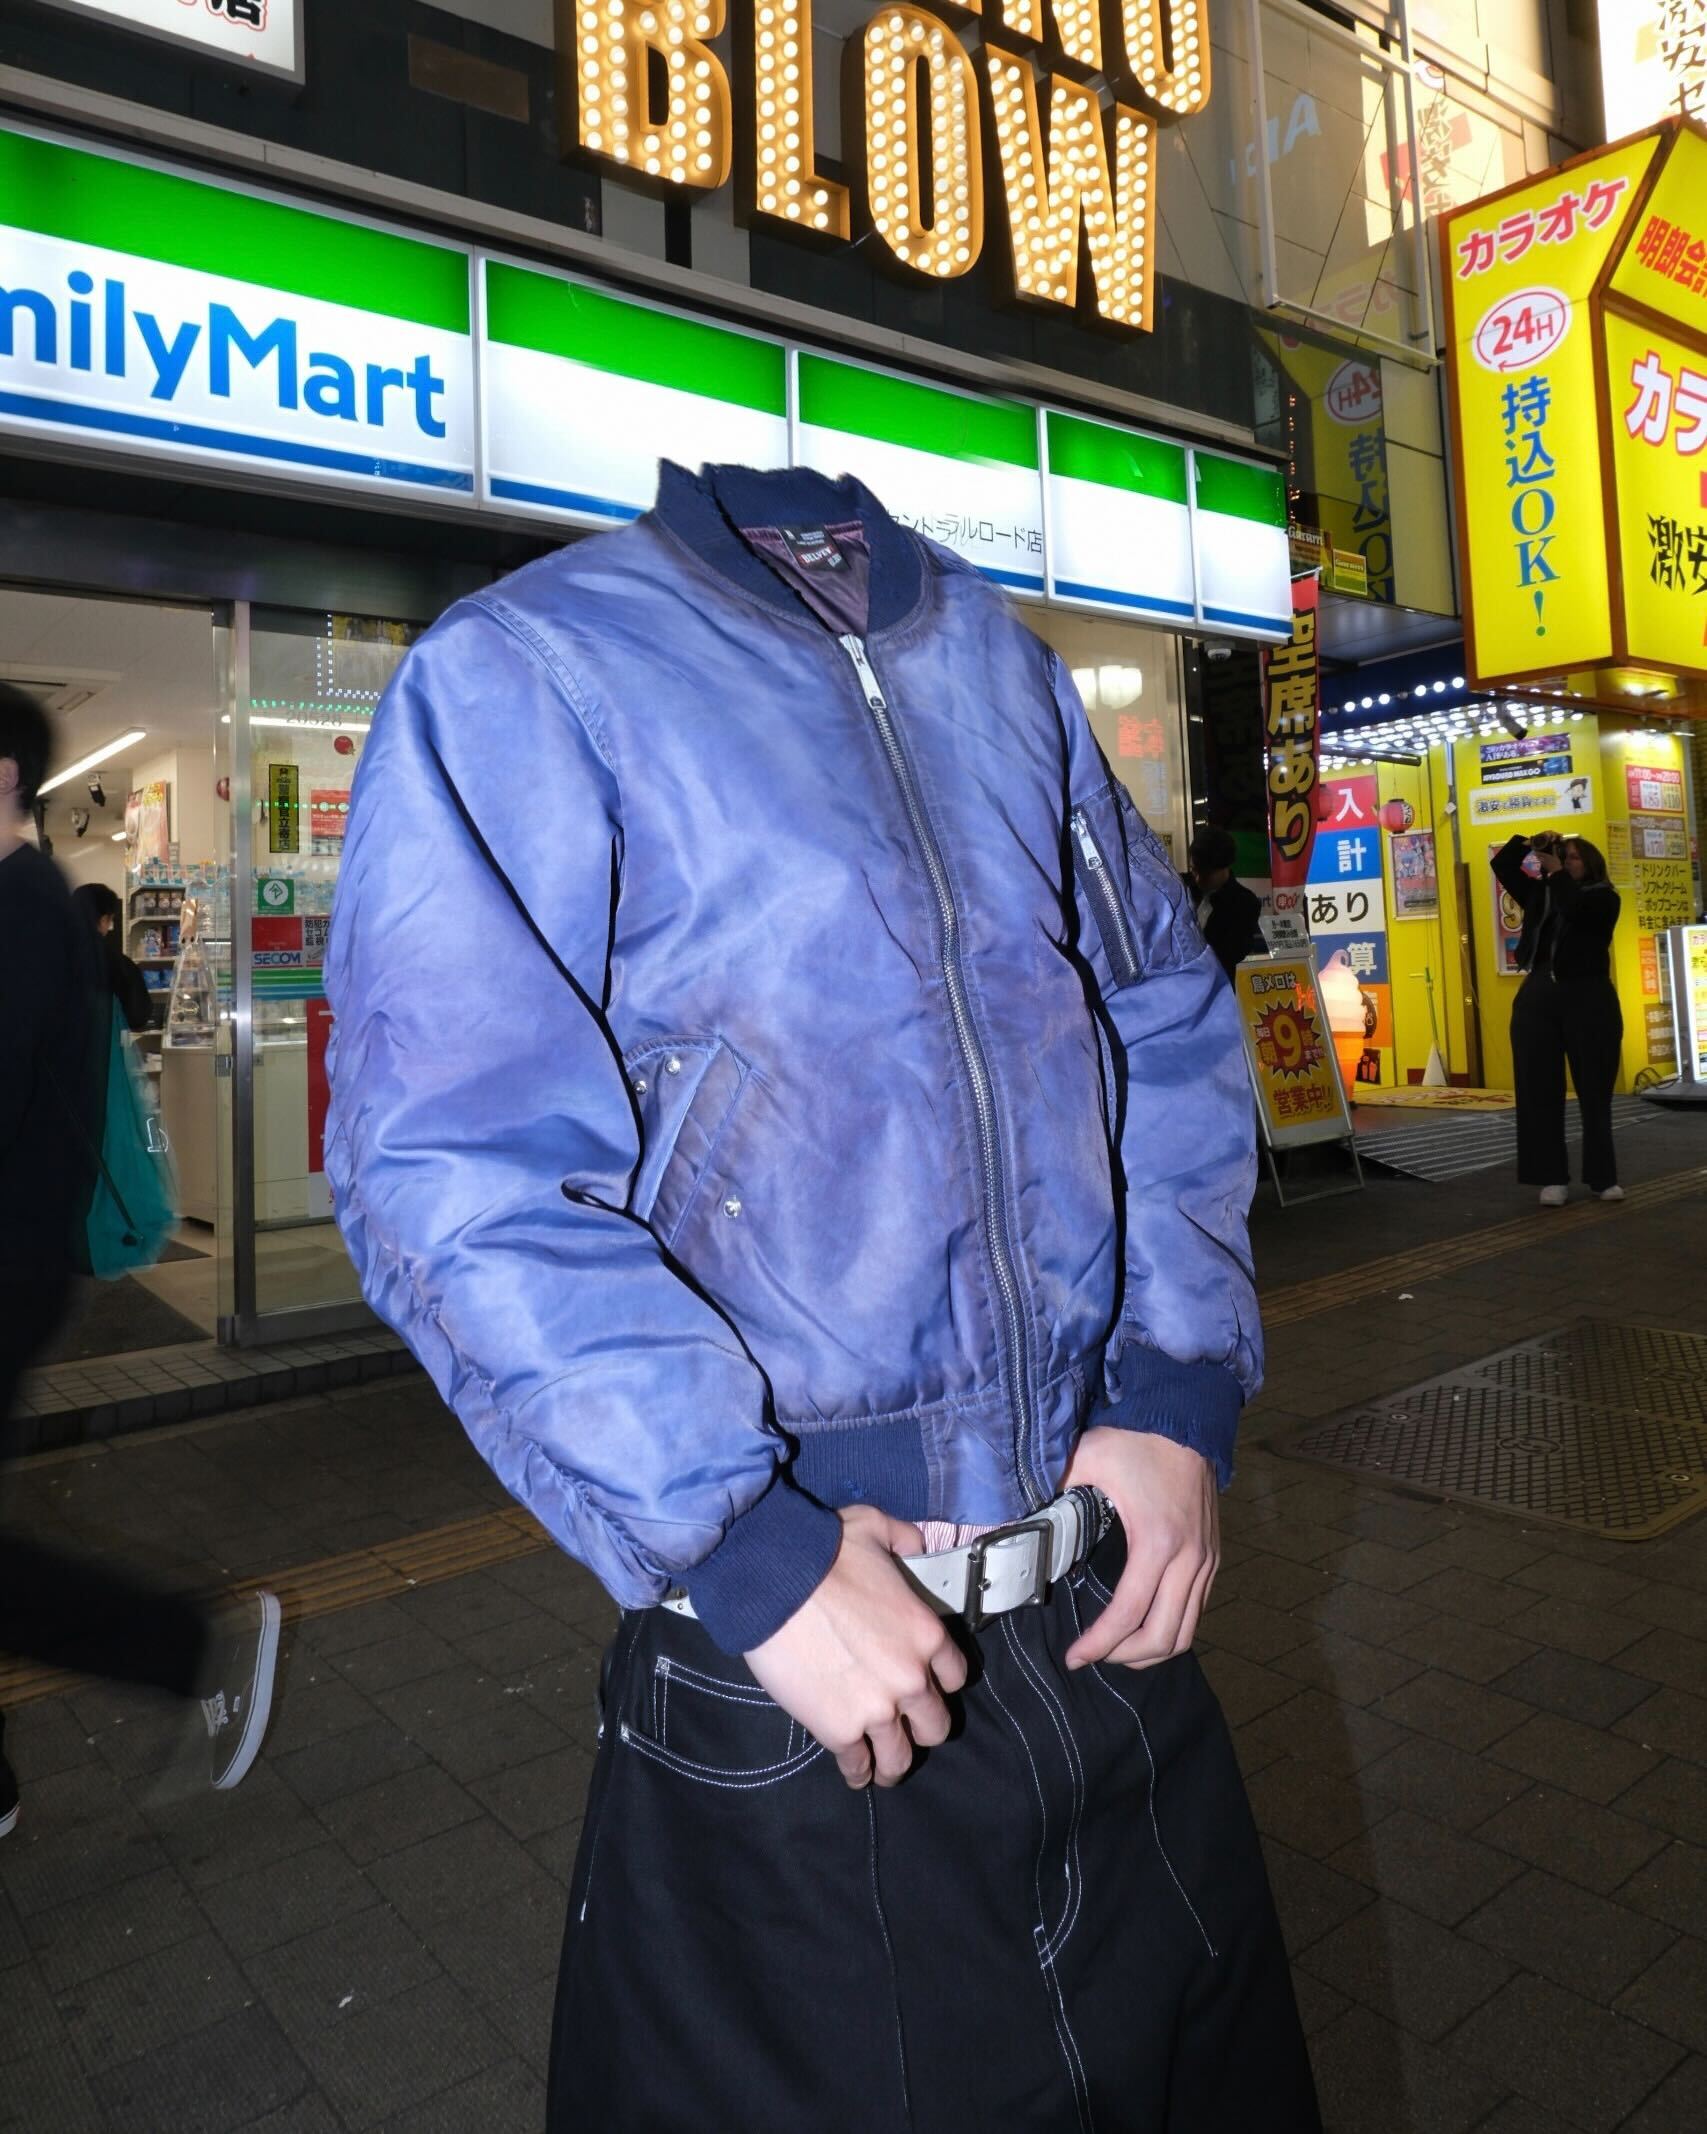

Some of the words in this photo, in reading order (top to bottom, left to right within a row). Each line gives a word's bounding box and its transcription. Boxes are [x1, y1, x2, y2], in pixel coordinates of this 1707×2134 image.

[574, 0, 1158, 333] BLOW
[1458, 178, 1628, 277] カラオケ
[1491, 306, 1555, 357] 24H
[1335, 787, 1364, 822] 入
[1337, 837, 1367, 873] 計
[254, 952, 301, 965] SECOM
